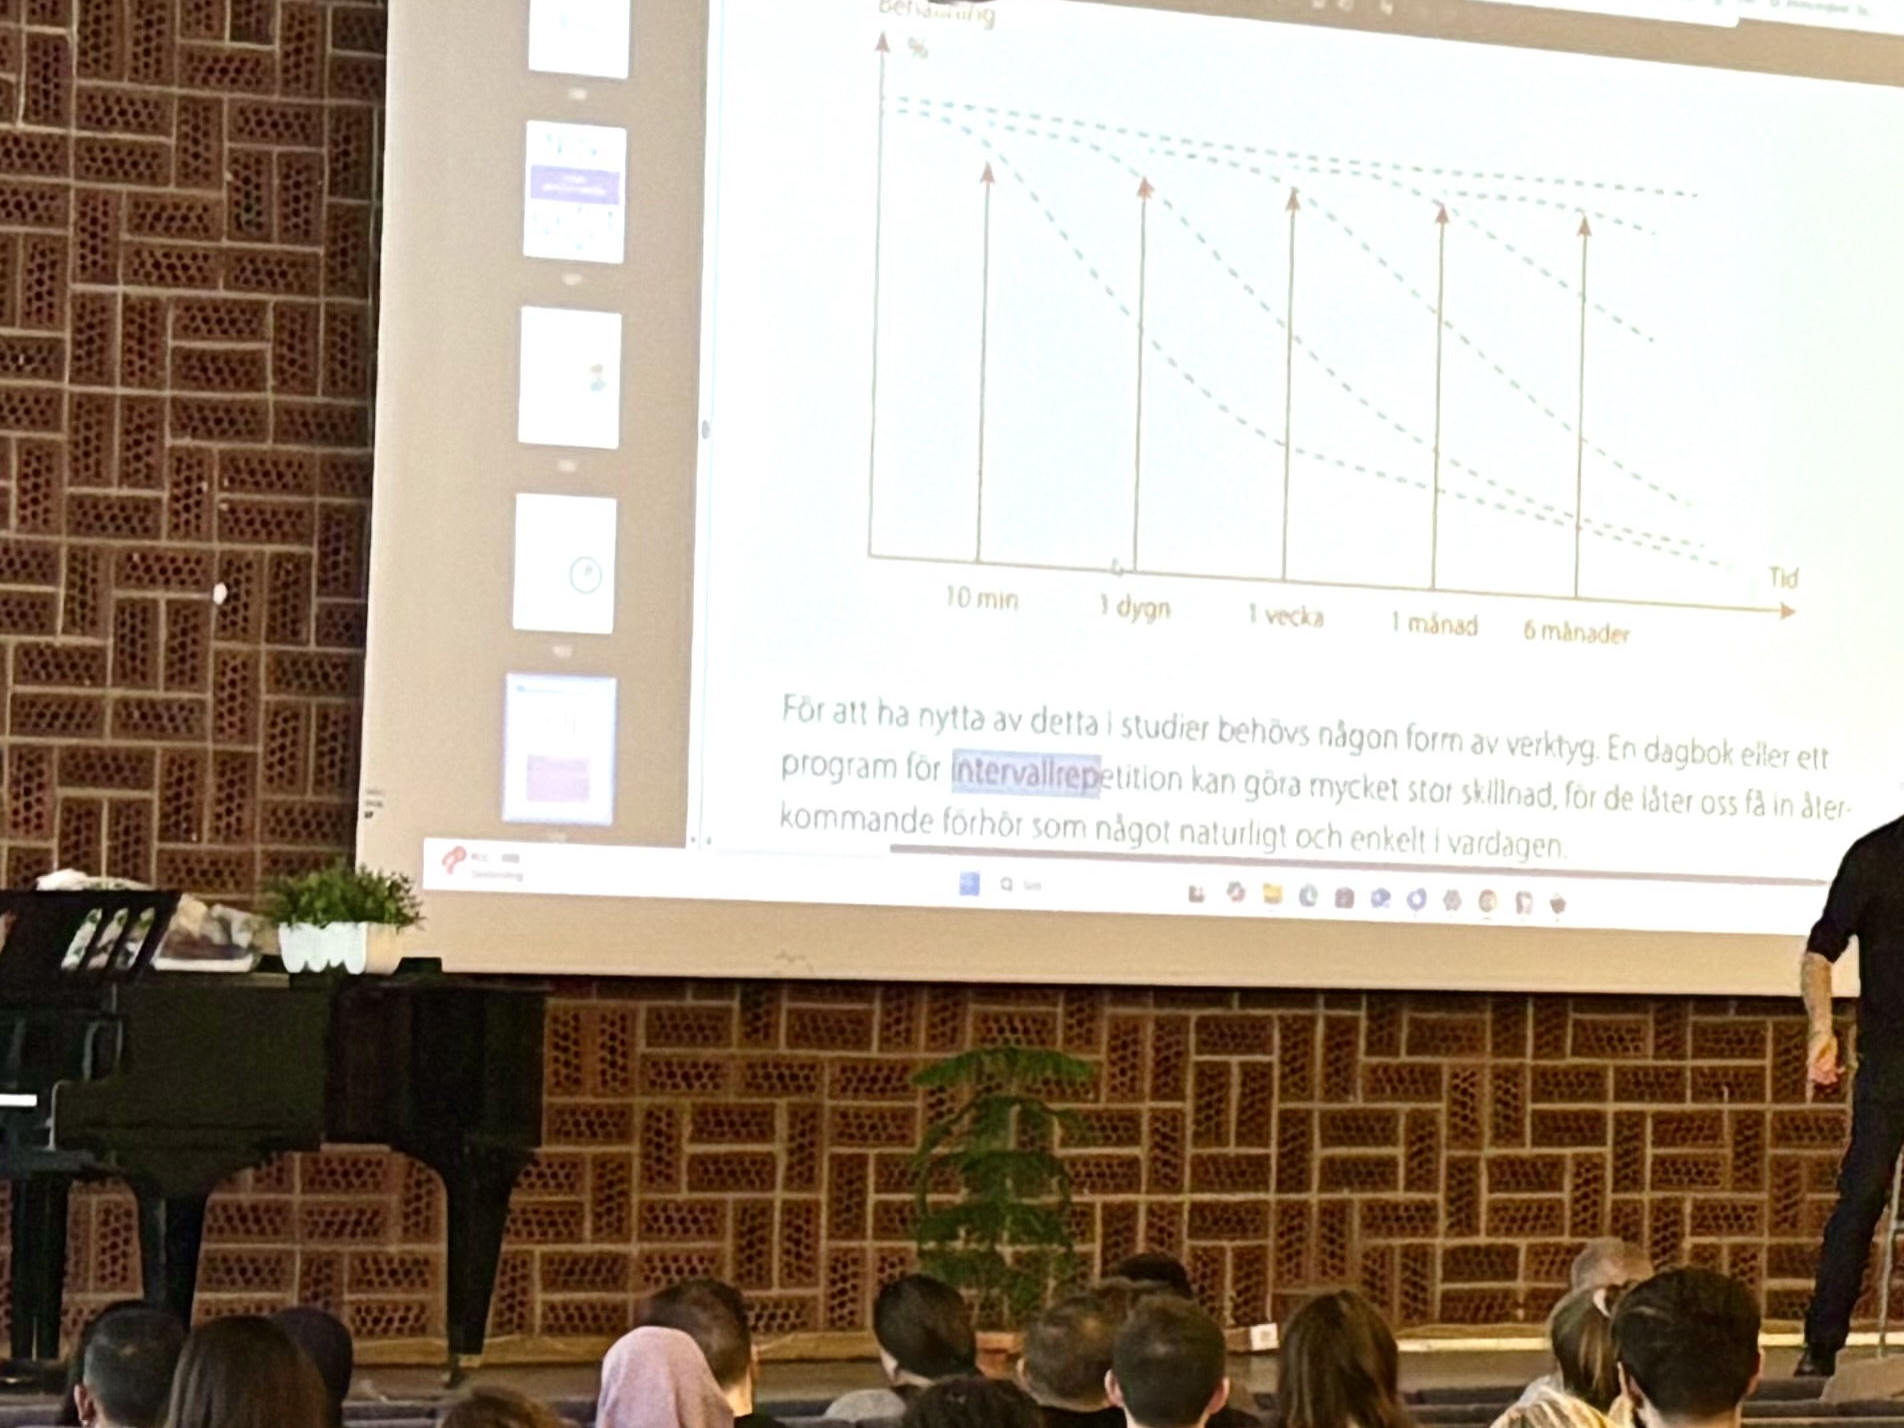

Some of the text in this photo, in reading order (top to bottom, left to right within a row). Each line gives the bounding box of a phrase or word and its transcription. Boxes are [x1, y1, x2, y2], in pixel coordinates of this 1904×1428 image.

[1769, 566, 1799, 589] Tid
[947, 584, 1018, 611] 10 min
[1101, 594, 1171, 624] 1 dygn
[1250, 603, 1324, 628] 1 vecka
[1392, 612, 1478, 637] 1 månad
[1524, 619, 1631, 645] 6 månader
[783, 693, 1829, 771] För att ha nytta av detta i studier behövs någon form av verktyg. En dagbok eller ett
[782, 751, 1852, 821] program för intervallrepetition kan göra mycket stor skillnad, för de låter oss få in åter-
[780, 801, 1567, 863] kommande förhör som något naturligt och enkelt i vardagen.
